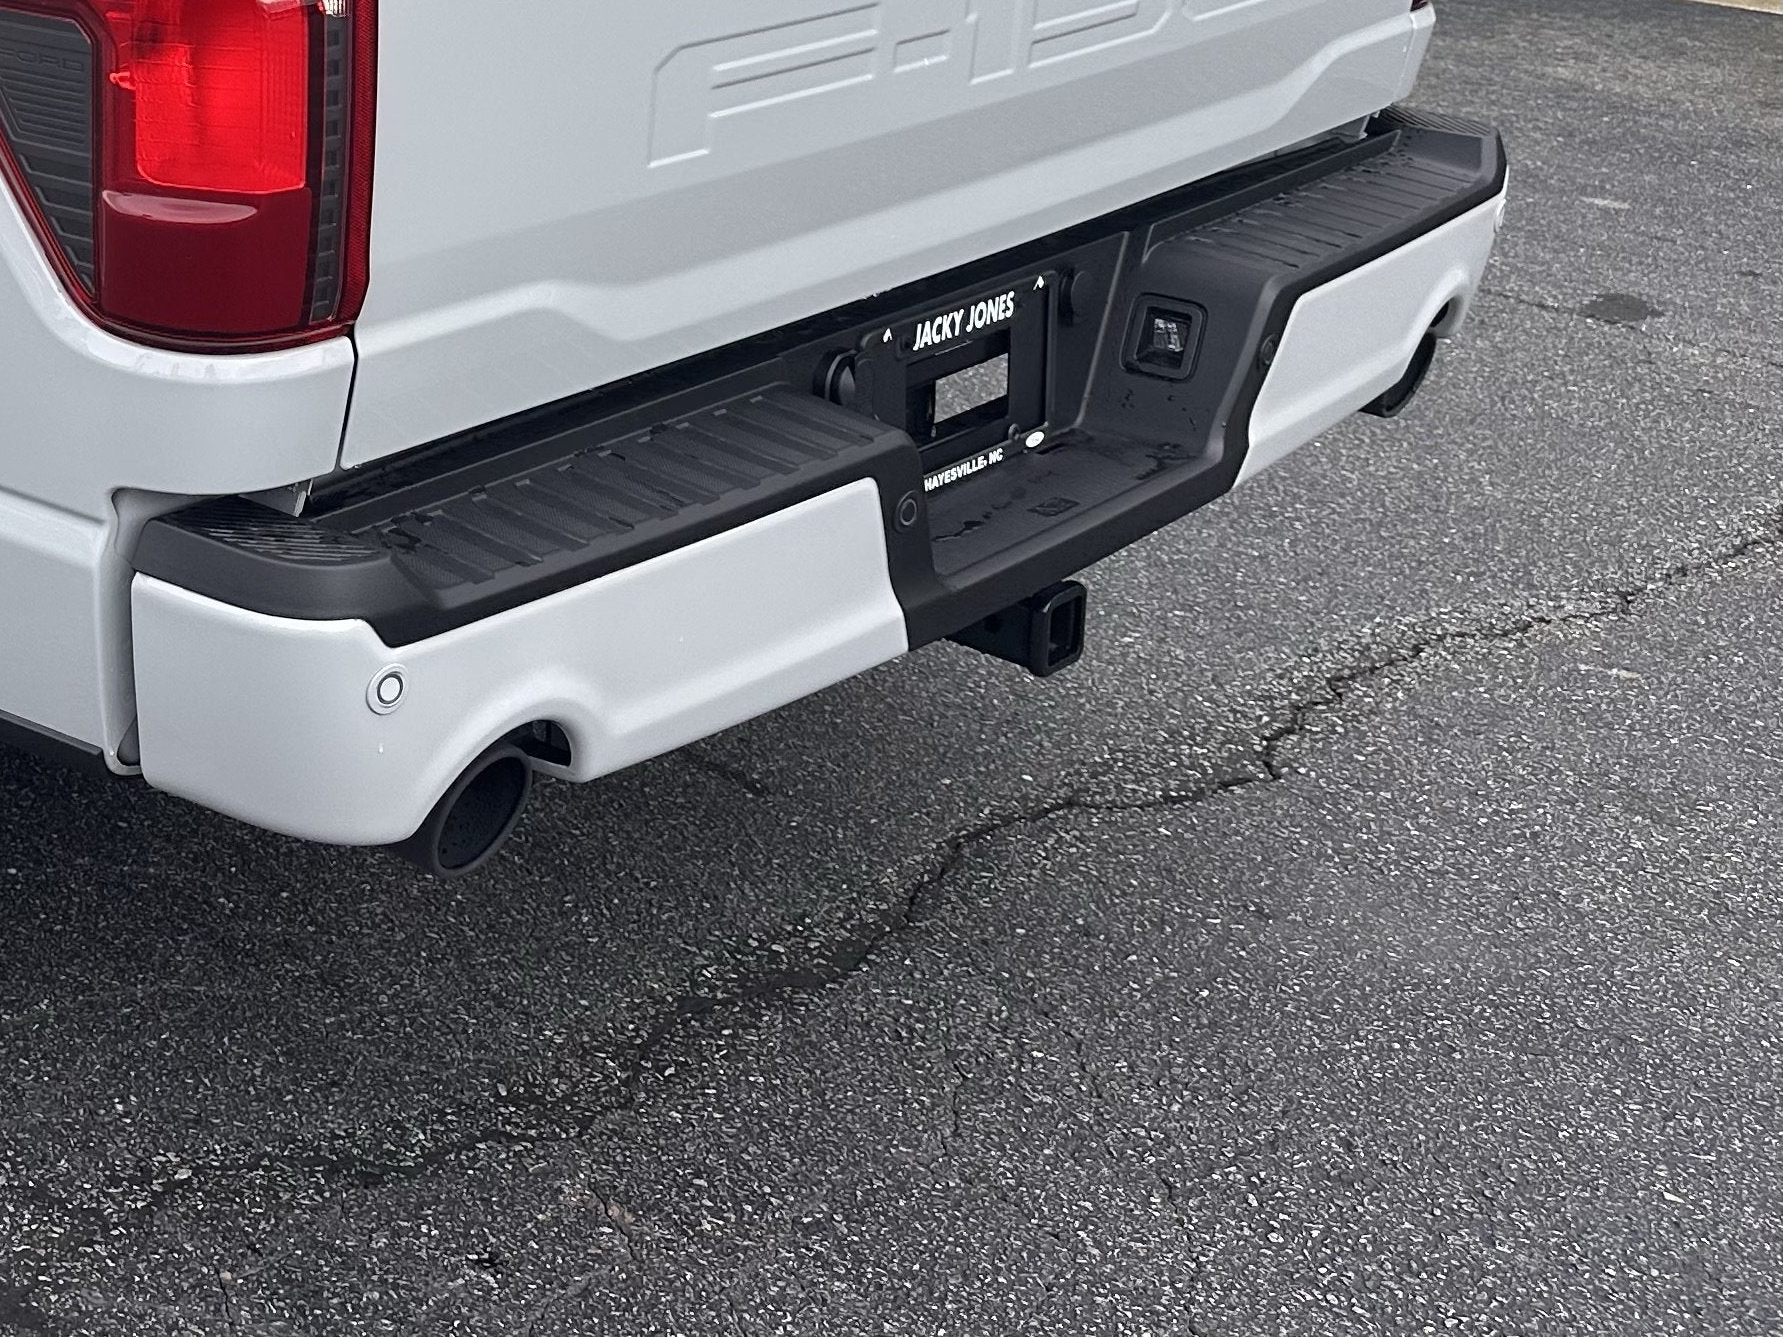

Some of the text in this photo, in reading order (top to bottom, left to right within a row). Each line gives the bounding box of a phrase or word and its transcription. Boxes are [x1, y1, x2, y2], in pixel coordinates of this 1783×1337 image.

[913, 290, 1015, 351] JACKY JONES
[988, 448, 1003, 464] NC
